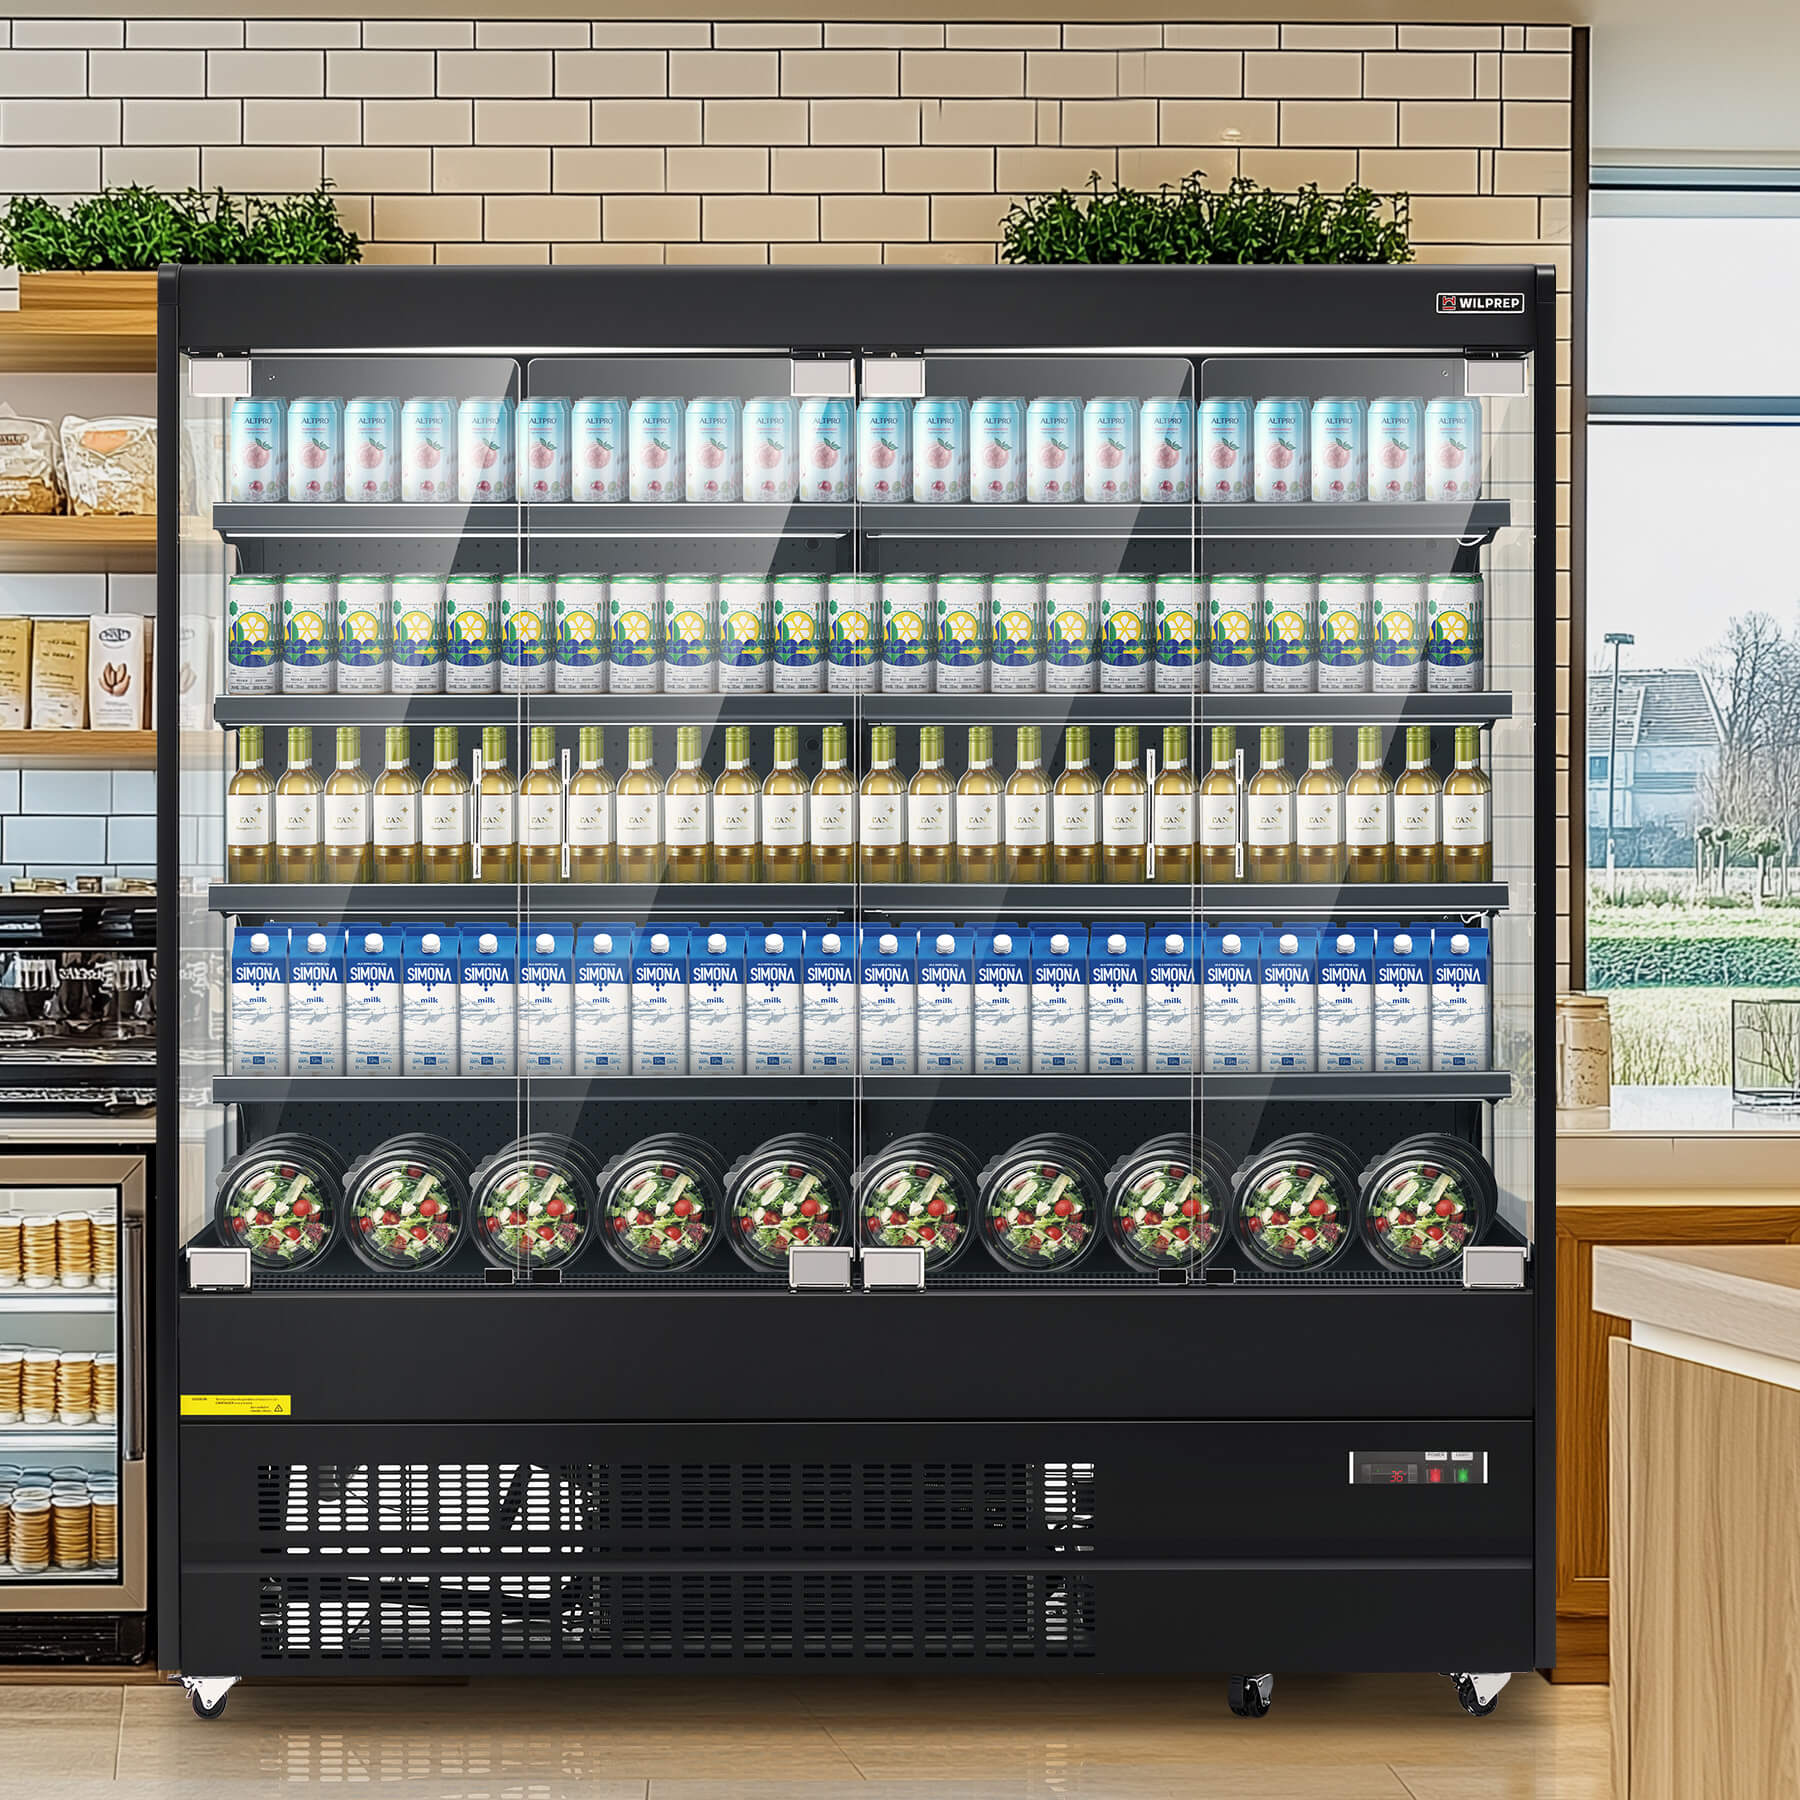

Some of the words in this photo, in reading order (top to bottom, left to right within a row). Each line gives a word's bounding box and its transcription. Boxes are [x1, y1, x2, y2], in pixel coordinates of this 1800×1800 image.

[1459, 297, 1520, 309] WILPREP
[244, 417, 272, 425] ALTPRO
[301, 417, 329, 425] ALTPRO
[358, 417, 386, 425] ALTPRO
[415, 417, 443, 425] ALTPRO
[471, 417, 499, 425] ALTPRO
[529, 417, 557, 425] ALTPRO
[585, 417, 613, 425] ALTPRO
[642, 417, 670, 425] ALTPRO
[699, 417, 727, 425] ALTPRO
[756, 417, 784, 425] ALTPRO
[813, 417, 841, 425] ALTPRO
[870, 417, 898, 425] ALTPRO
[926, 417, 954, 425] ALTPRO
[983, 417, 1011, 425] ALTPRO
[1040, 417, 1068, 425] ALTPRO
[1097, 417, 1125, 425] ALTPRO
[1154, 417, 1182, 425] ALTPRO
[1211, 417, 1239, 425] ALTPRO
[1267, 417, 1295, 425] ALTPRO
[1324, 417, 1352, 425] ALTPRO
[1381, 417, 1409, 425] ALTPRO
[1438, 417, 1466, 425] ALTPRO
[236, 966, 280, 981] SIMONA
[293, 966, 337, 981] SIMONA
[350, 966, 394, 981] SIMONA
[407, 966, 451, 981] SIMONA
[464, 966, 508, 981] SIMONA
[521, 966, 565, 981] SIMONA
[579, 966, 623, 981] SIMONA
[636, 966, 680, 981] SIMONA
[693, 966, 737, 981] SIMONA
[750, 966, 794, 981] SIMONA
[807, 966, 851, 981] SIMONA
[865, 967, 909, 982] SIMONA
[922, 967, 966, 982] SIMONA
[979, 967, 1023, 982] SIMONA
[1036, 967, 1080, 982] SIMONA
[1093, 967, 1137, 982] SIMONA
[1151, 967, 1195, 982] SIMONA
[1208, 967, 1252, 982] SIMONA
[1265, 967, 1309, 982] SIMONA
[1322, 967, 1366, 982] SIMONA
[1379, 967, 1423, 982] SIMONA
[1436, 967, 1480, 982] SIMONA
[249, 996, 267, 1004] milk
[306, 996, 324, 1004] milk
[363, 996, 381, 1004] milk
[420, 996, 438, 1004] milk
[477, 996, 495, 1004] milk
[534, 996, 552, 1004] milk
[592, 996, 610, 1004] milk
[649, 996, 667, 1004] milk
[706, 996, 724, 1004] milk
[763, 996, 781, 1004] milk
[820, 996, 838, 1004] milk
[878, 997, 896, 1005] milk
[935, 997, 953, 1005] milk
[992, 997, 1010, 1005] milk
[1049, 997, 1067, 1005] milk
[1106, 997, 1124, 1005] milk
[1164, 997, 1182, 1005] milk
[1221, 997, 1239, 1005] milk
[1278, 997, 1296, 1005] milk
[1335, 997, 1353, 1005] milk
[1392, 997, 1410, 1005] milk
[1449, 997, 1467, 1005] milk
